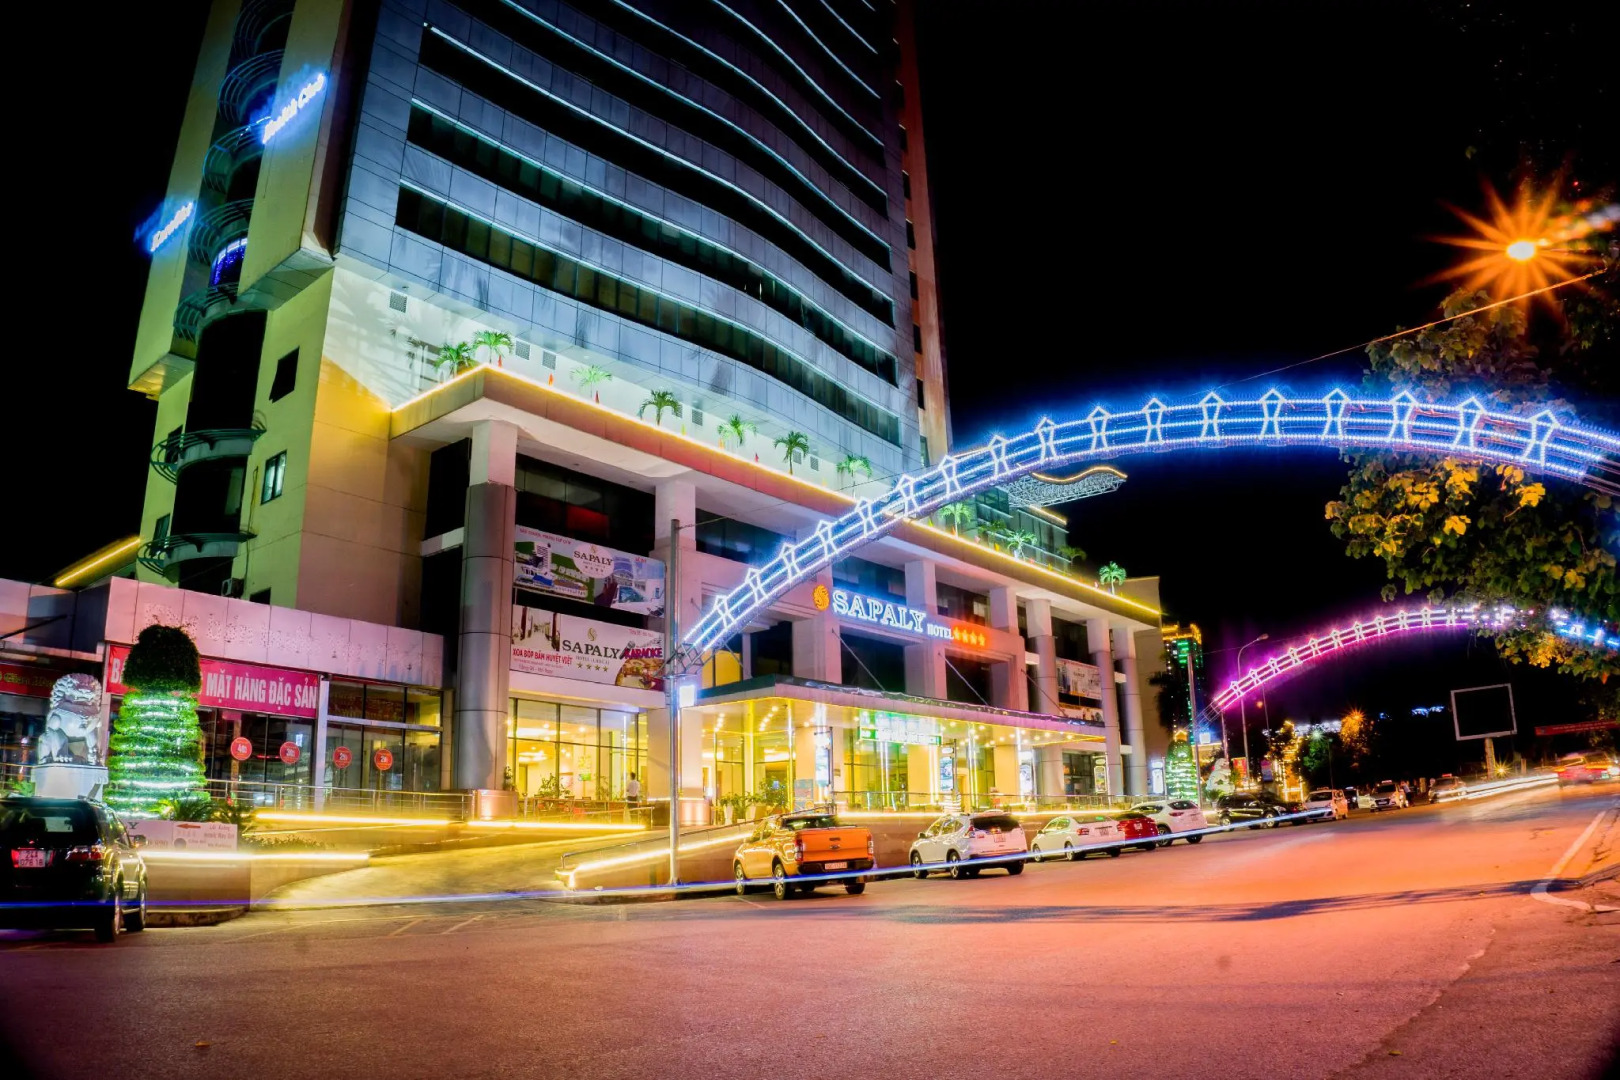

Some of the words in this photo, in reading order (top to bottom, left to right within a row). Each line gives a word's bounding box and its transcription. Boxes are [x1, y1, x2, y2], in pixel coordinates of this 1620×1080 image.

[573, 550, 614, 566] SAPALY
[832, 590, 926, 633] SAPALY
[927, 623, 954, 640] HOTEL
[562, 640, 620, 659] SAPALY
[624, 647, 663, 659] KARAOKE
[206, 669, 232, 703] MẶT
[234, 672, 265, 703] HÀNG
[268, 676, 291, 710] ĐẶC
[294, 677, 317, 709] SẢN
